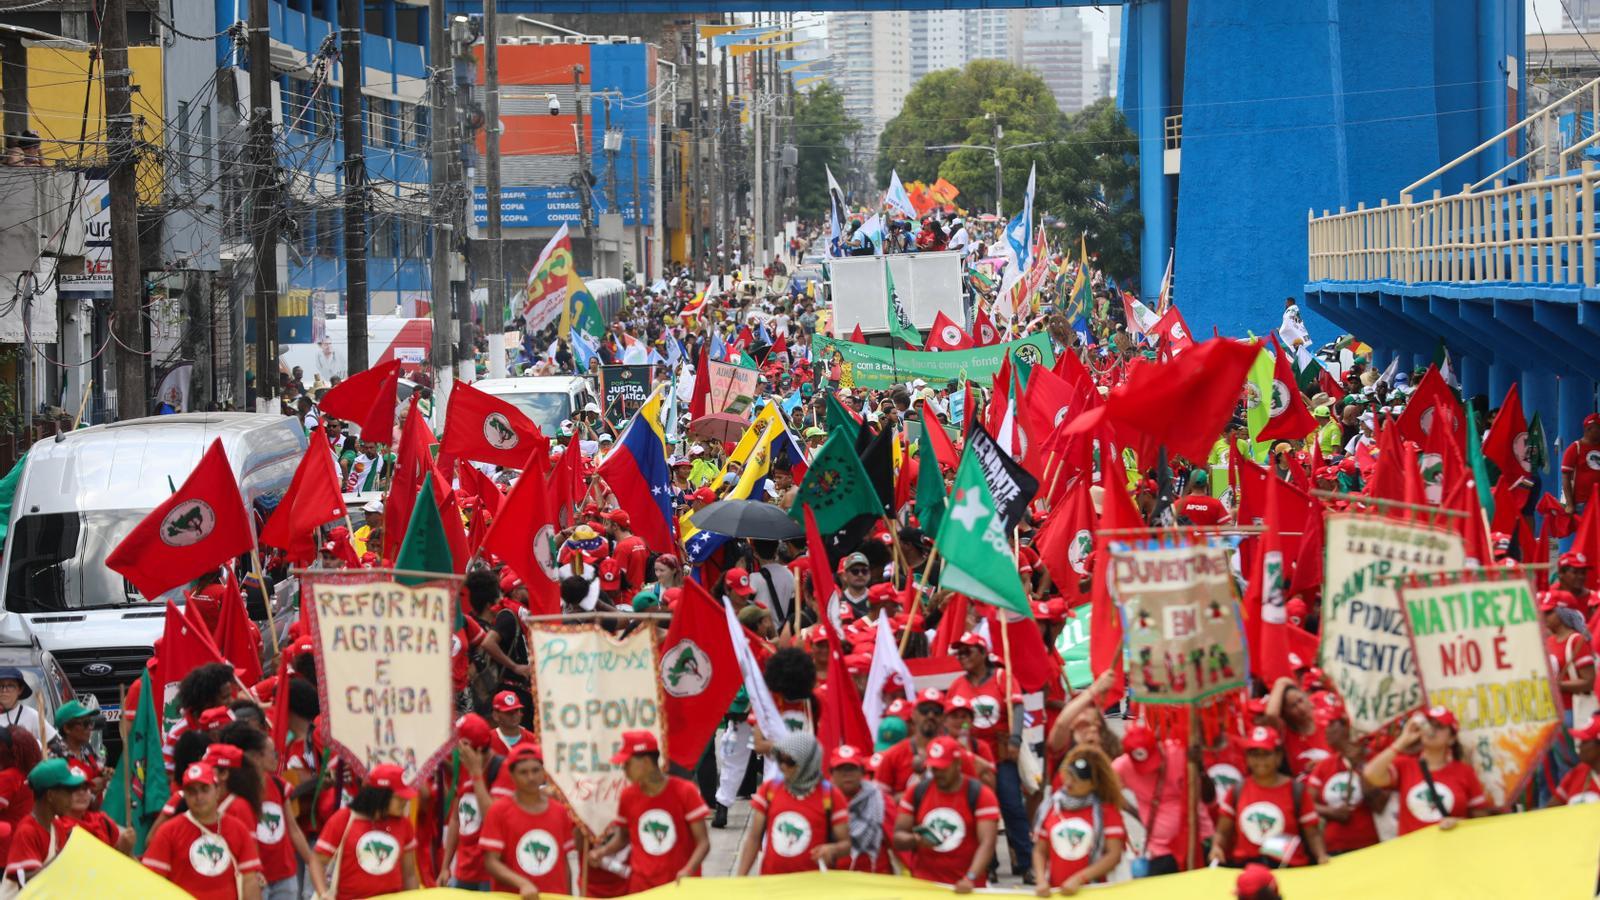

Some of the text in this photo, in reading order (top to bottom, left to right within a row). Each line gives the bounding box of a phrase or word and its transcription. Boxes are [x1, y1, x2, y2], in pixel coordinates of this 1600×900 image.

[318, 591, 444, 622] REFORMA
[1493, 625, 1513, 670] É
[345, 686, 432, 717] COMIDA
[585, 697, 656, 730] POVO
